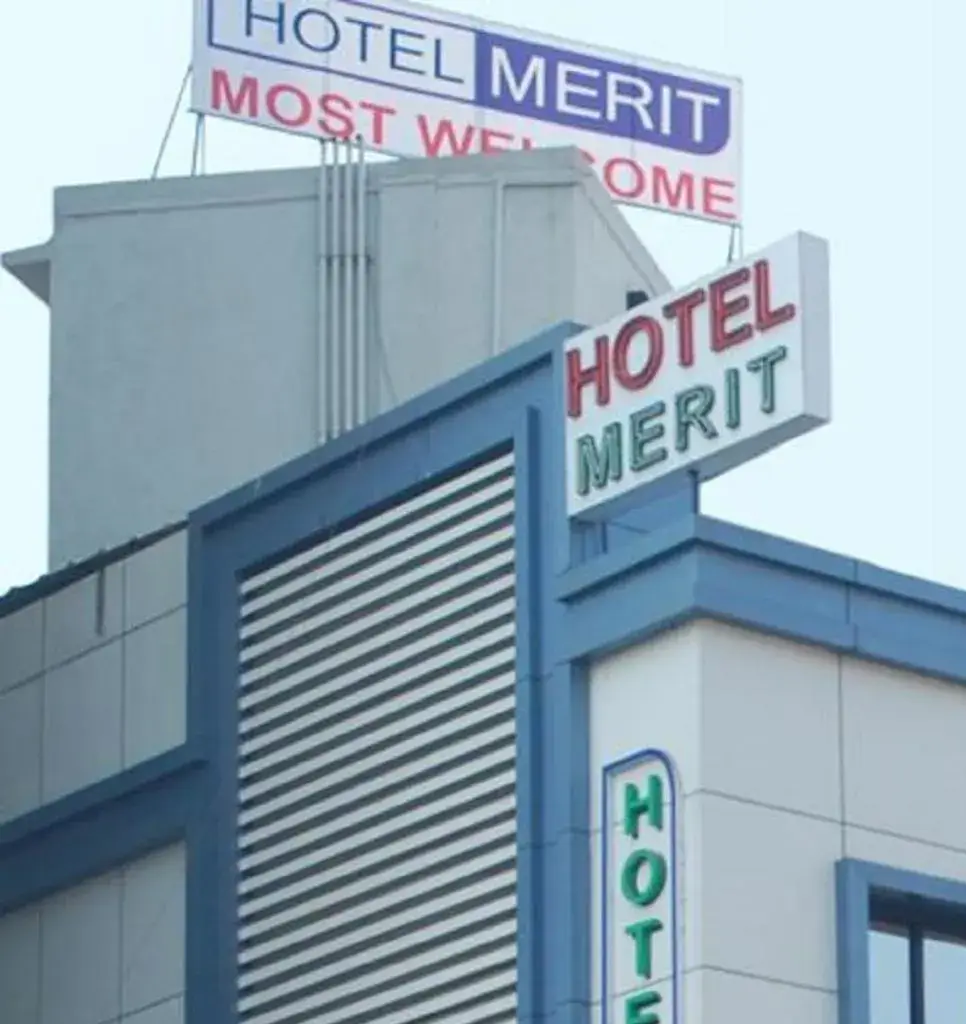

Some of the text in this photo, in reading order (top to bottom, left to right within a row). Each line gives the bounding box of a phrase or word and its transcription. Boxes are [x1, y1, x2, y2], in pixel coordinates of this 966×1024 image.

[211, 68, 737, 219] MOST WEOME
[246, 0, 721, 142] HOTEL MERIT
[566, 258, 796, 418] HOTEL
[576, 345, 789, 498] MERIT
